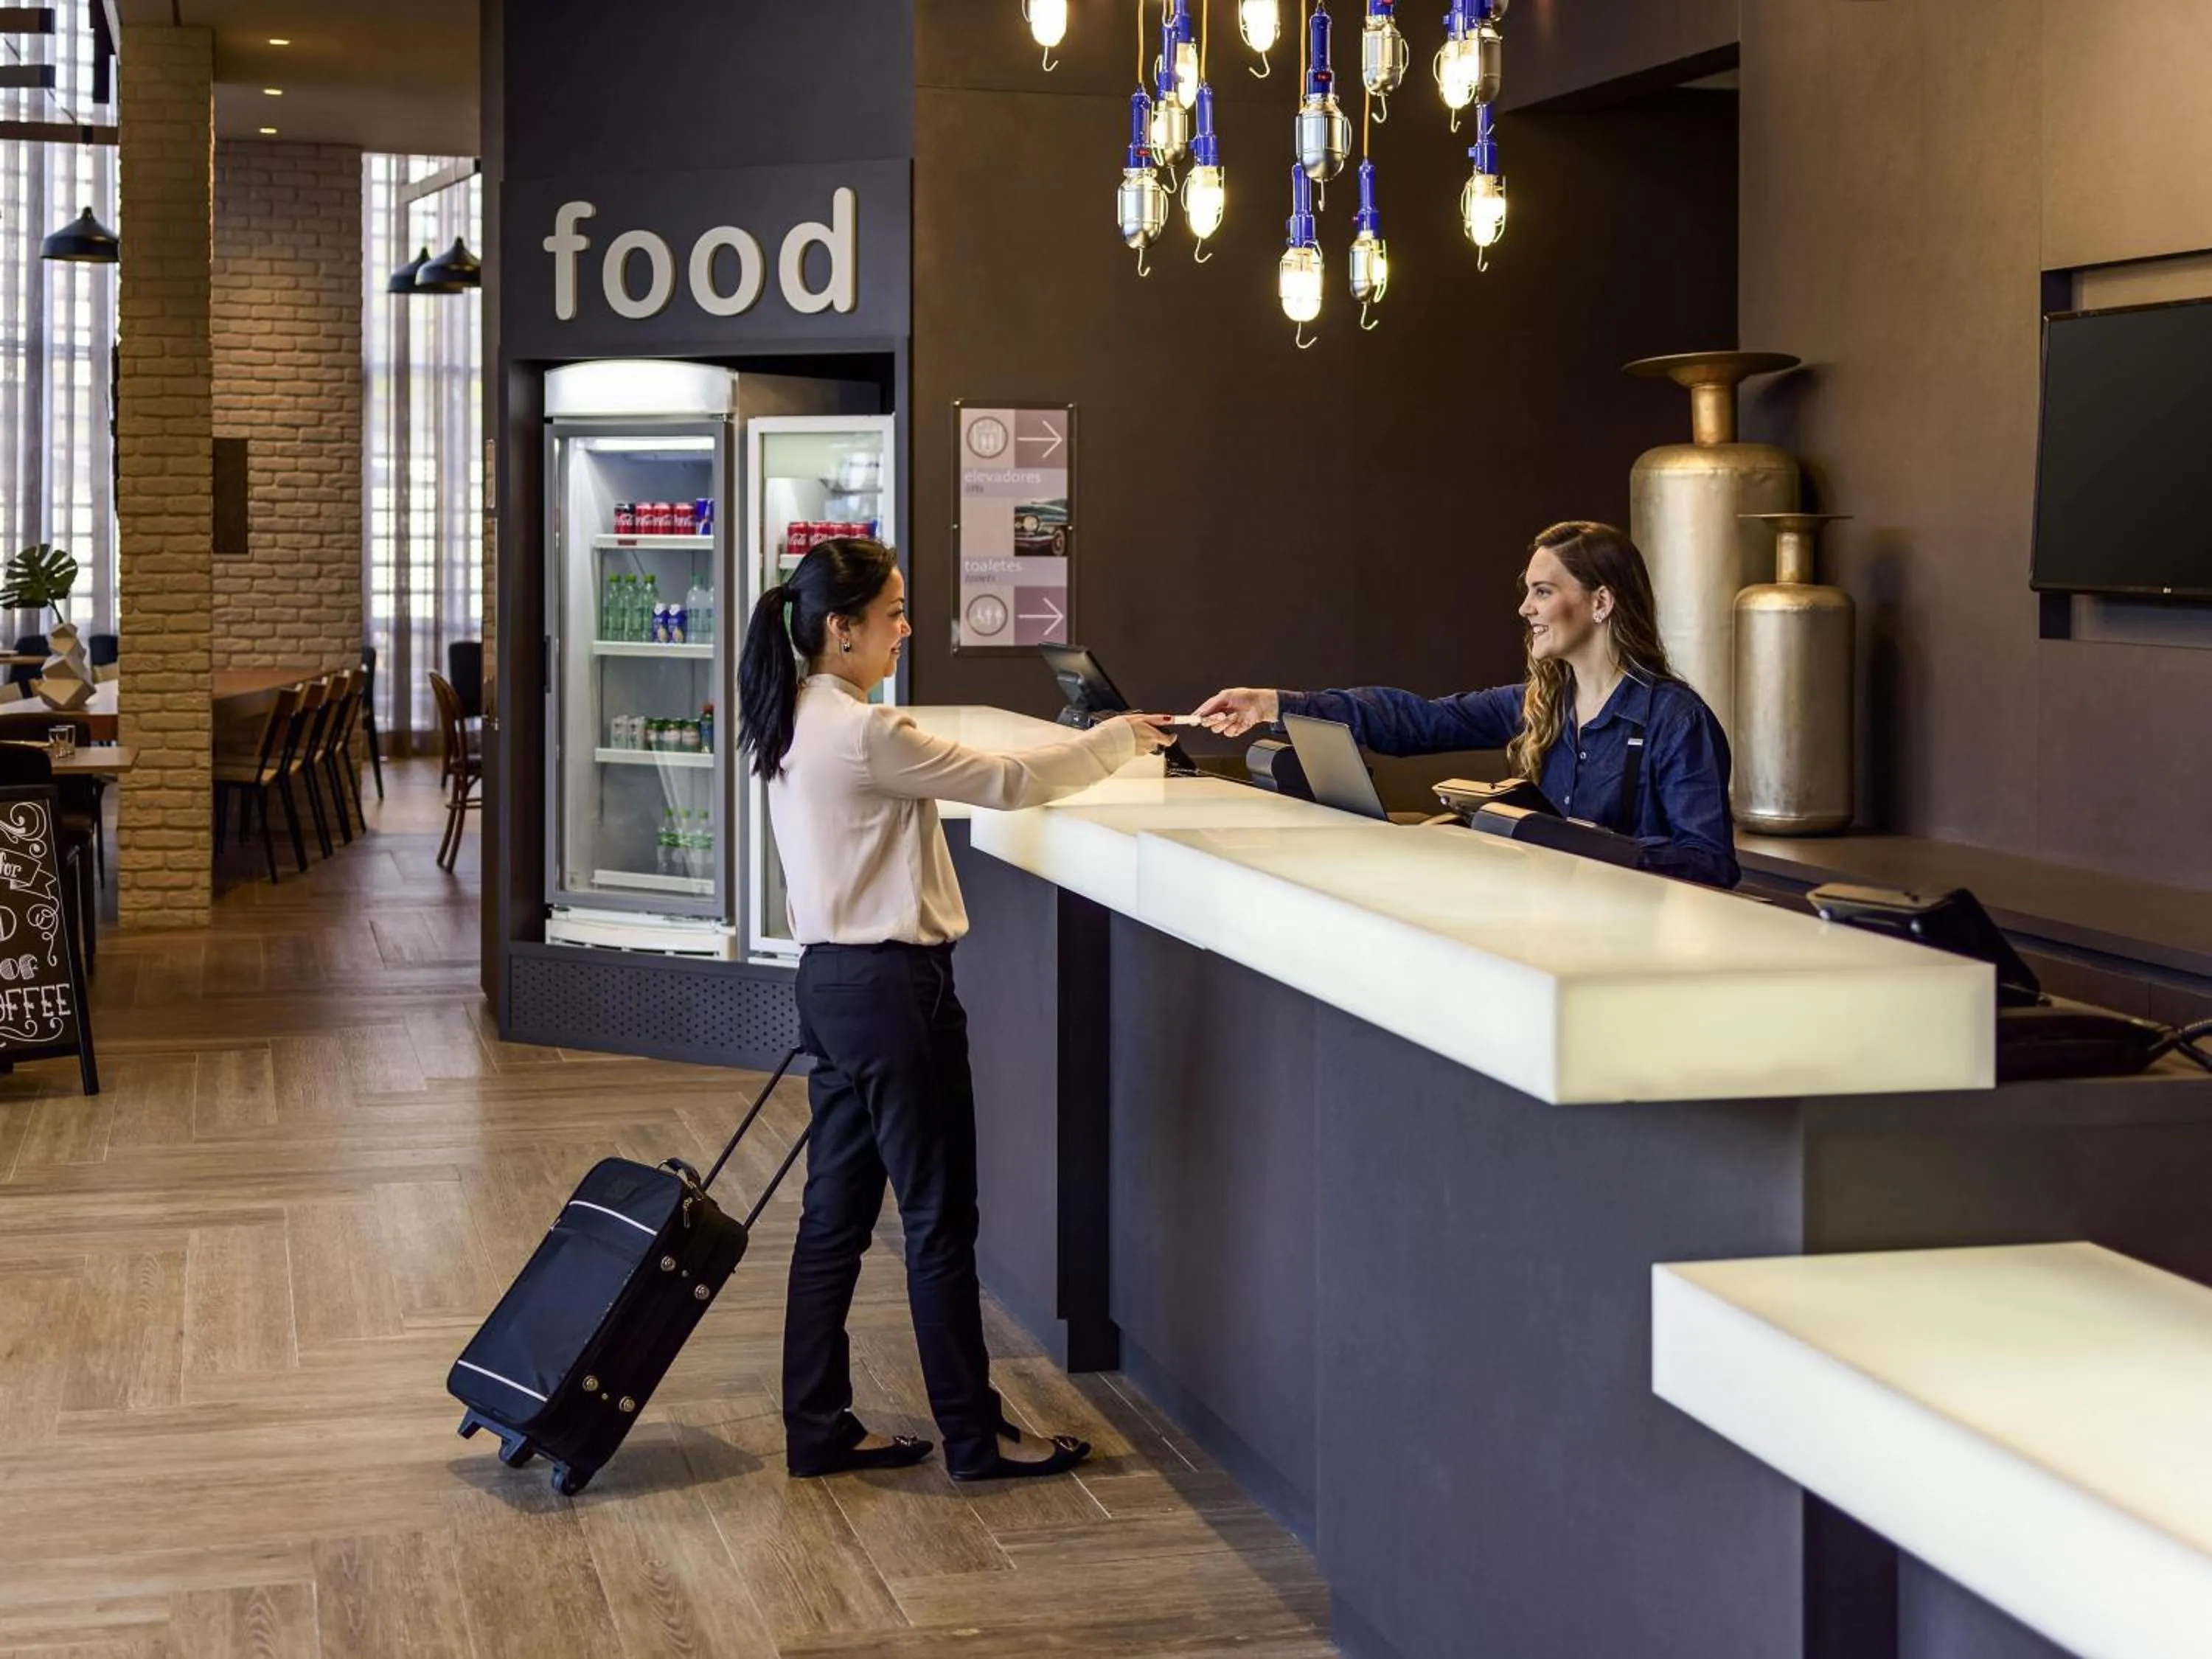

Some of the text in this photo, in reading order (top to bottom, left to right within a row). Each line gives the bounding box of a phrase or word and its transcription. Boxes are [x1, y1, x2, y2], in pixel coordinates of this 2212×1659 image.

[543, 187, 858, 320] food
[964, 470, 1041, 484] elevadores
[964, 560, 1022, 573] toaletes
